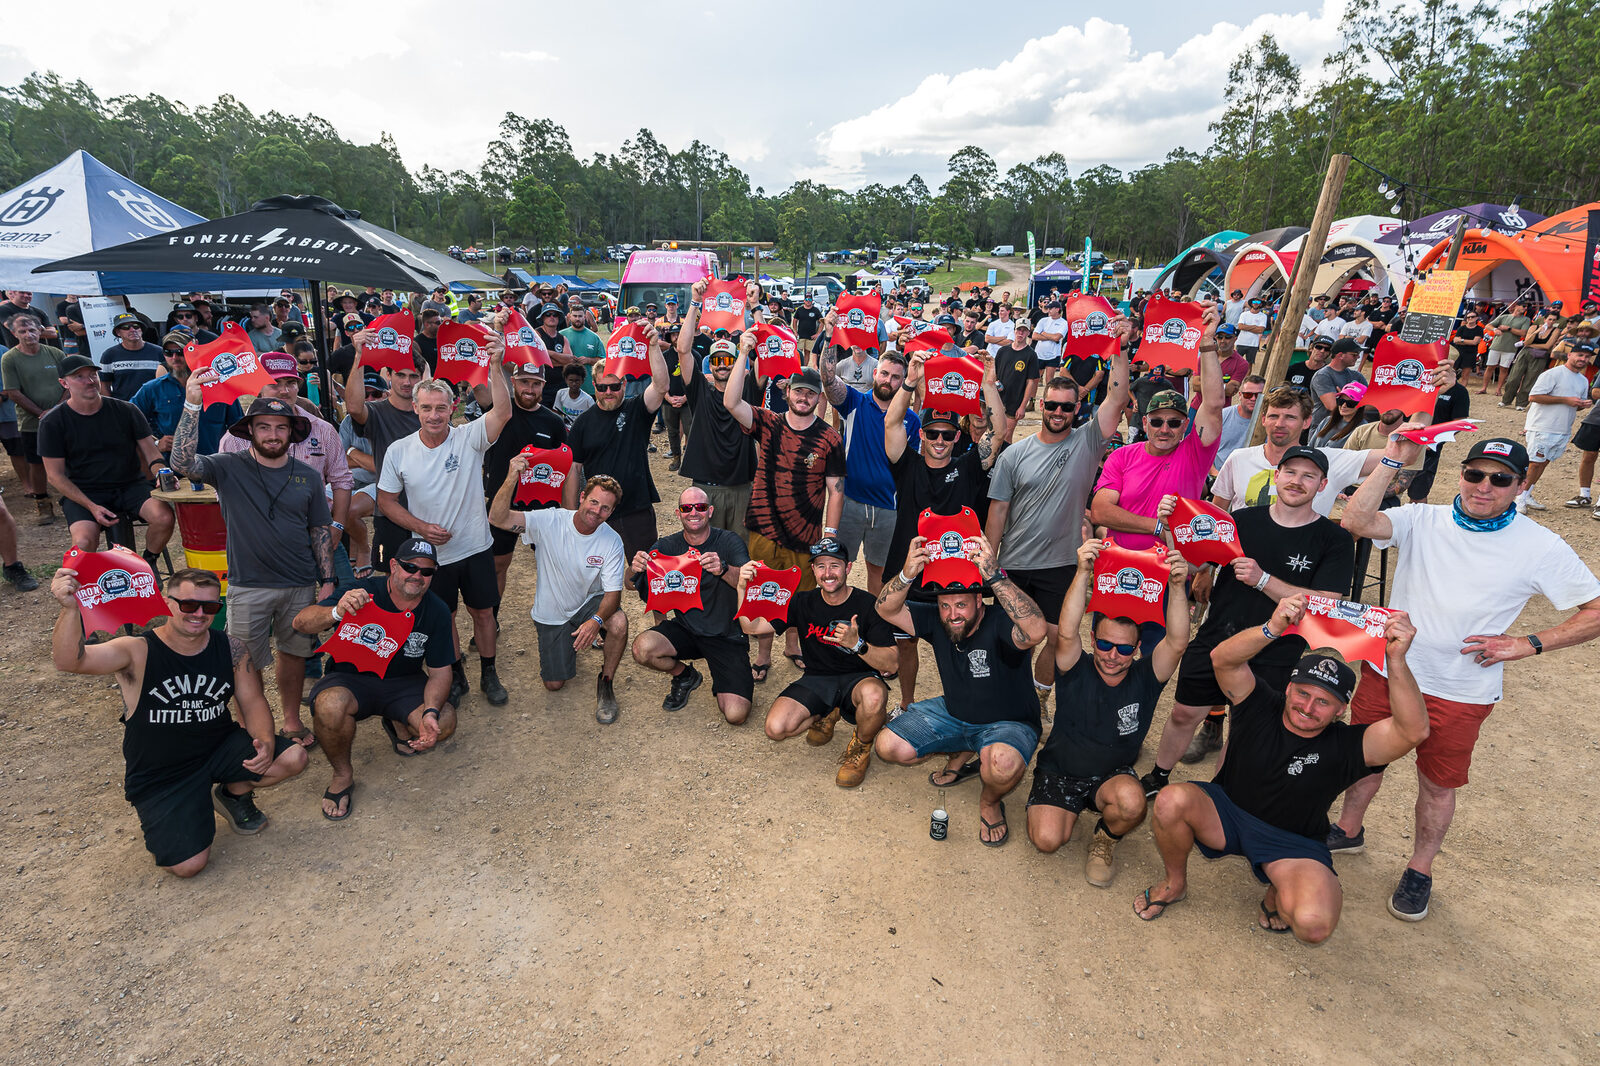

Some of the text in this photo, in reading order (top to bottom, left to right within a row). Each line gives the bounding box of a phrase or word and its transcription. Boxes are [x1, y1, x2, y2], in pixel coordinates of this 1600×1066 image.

[168, 234, 363, 256] FONZIE ABBOTT
[1462, 241, 1488, 256] KTM
[193, 252, 252, 261] ROASTING
[270, 255, 321, 264] BREWING
[633, 257, 702, 266] CAUTION CHILDREN
[213, 265, 286, 275] ALBION BNE
[1376, 367, 1395, 377] IRON
[1175, 526, 1192, 535] IRON
[1290, 559, 1308, 567] KSCY
[1099, 576, 1117, 585] IRON
[76, 585, 100, 598] IRON
[149, 674, 231, 704] TEMPLE
[191, 700, 204, 708] ART
[149, 709, 192, 723] LITTLE
